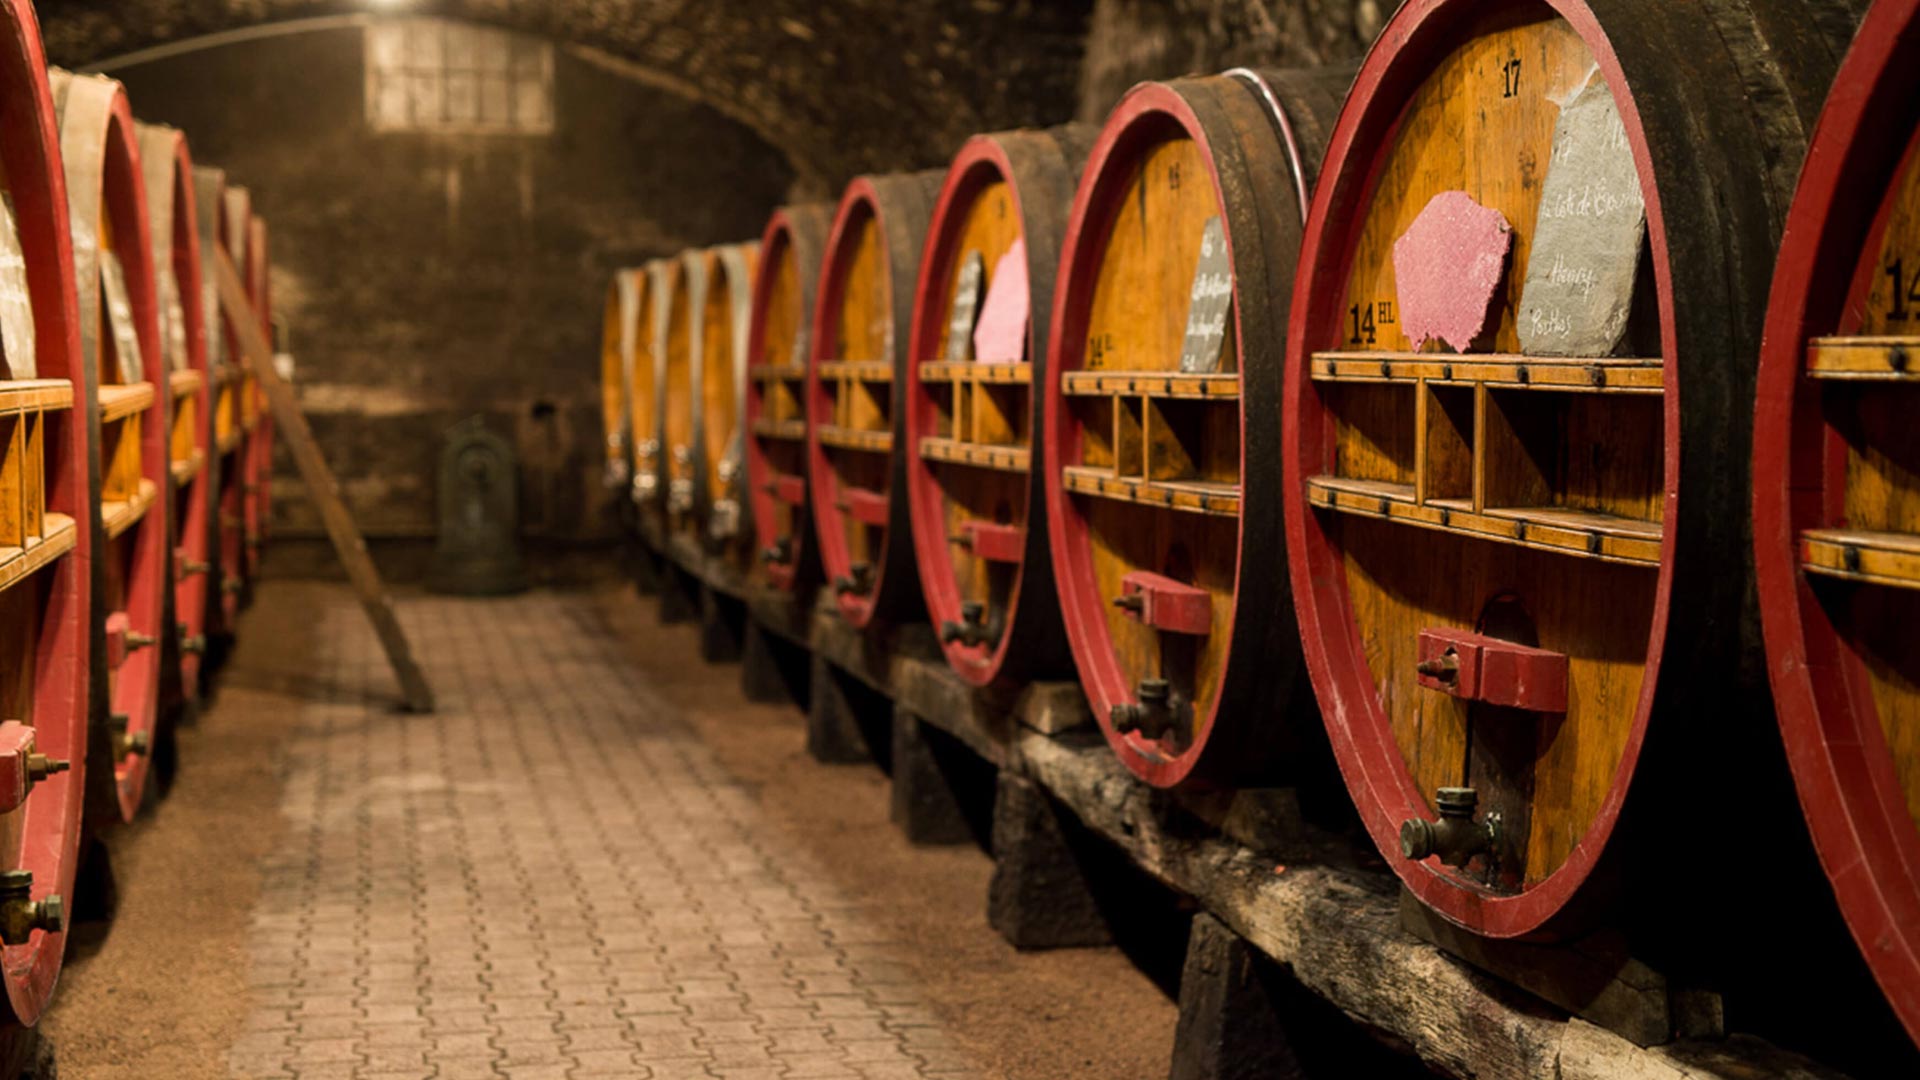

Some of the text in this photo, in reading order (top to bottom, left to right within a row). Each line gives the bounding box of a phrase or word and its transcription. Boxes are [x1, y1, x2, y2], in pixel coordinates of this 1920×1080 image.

[1502, 58, 1522, 98] 17
[1350, 302, 1395, 344] 14 HL
